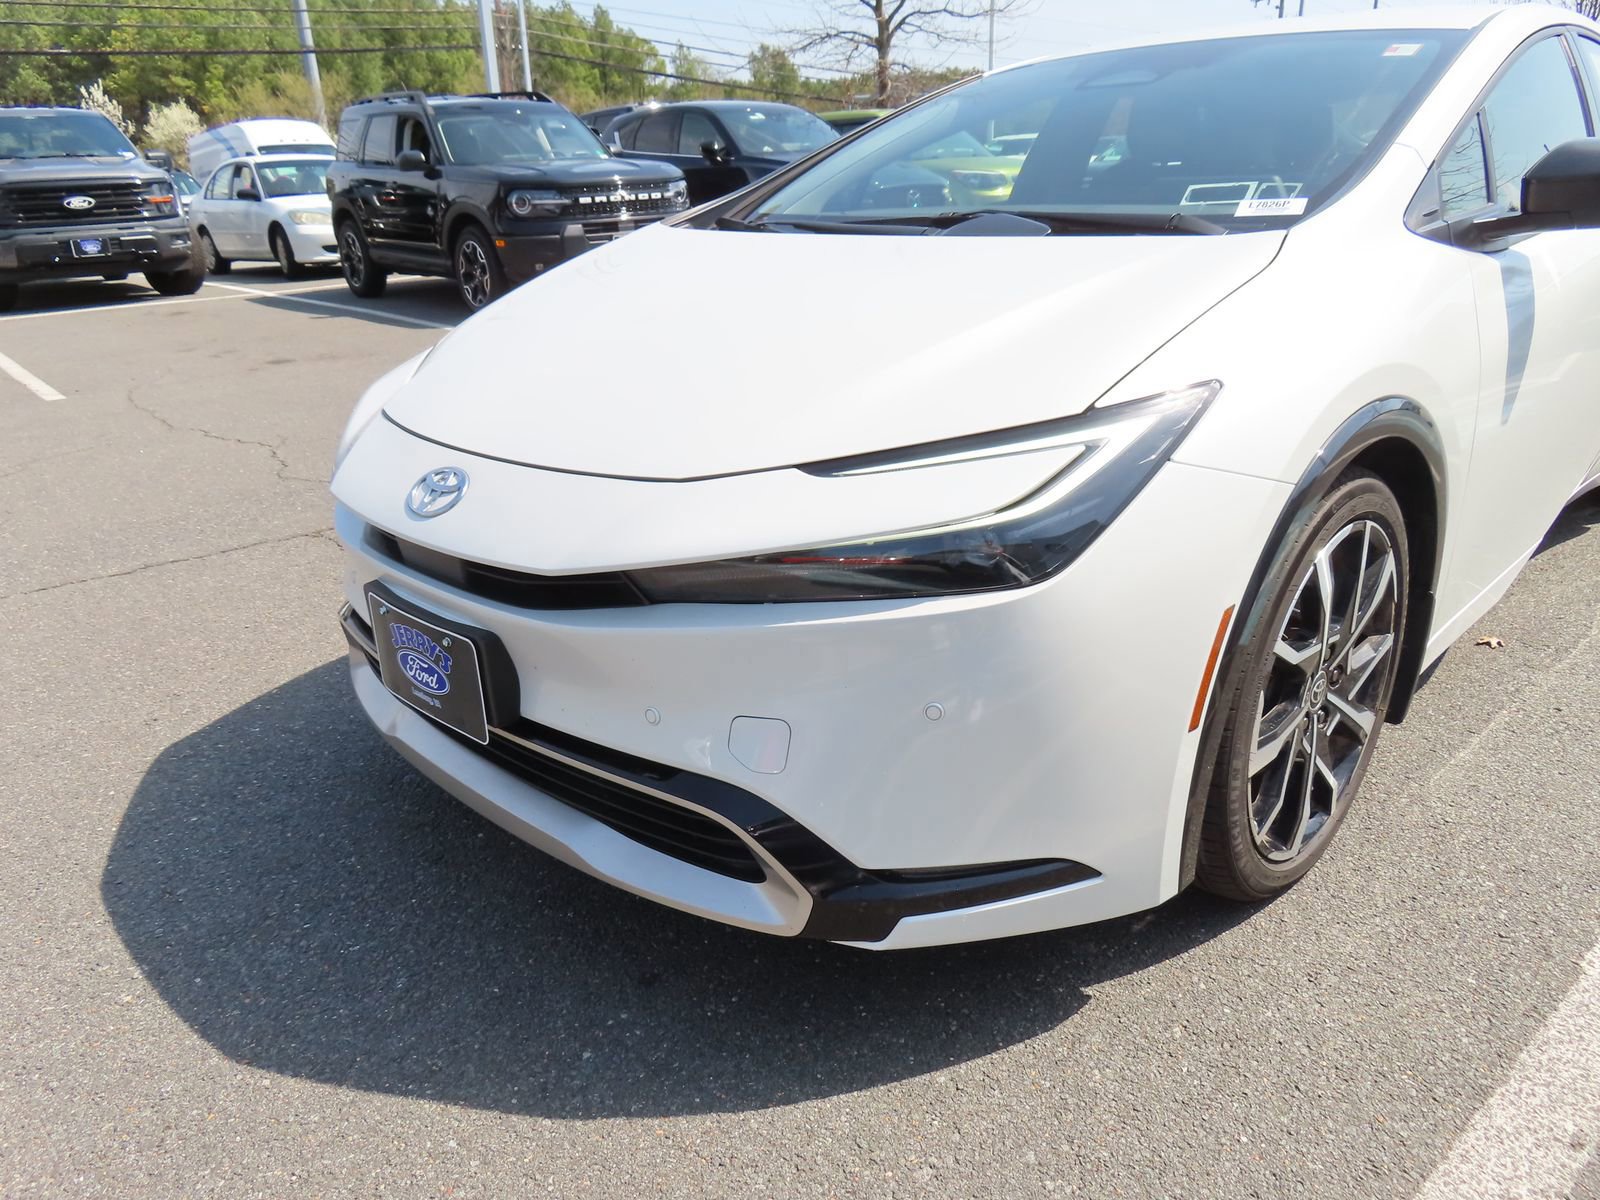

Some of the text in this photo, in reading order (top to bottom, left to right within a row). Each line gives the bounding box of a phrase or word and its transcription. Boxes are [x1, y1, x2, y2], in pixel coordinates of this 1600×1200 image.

[579, 191, 661, 204] BRONCO
[390, 623, 452, 674] JERRY'S
[407, 655, 438, 689] Ford
